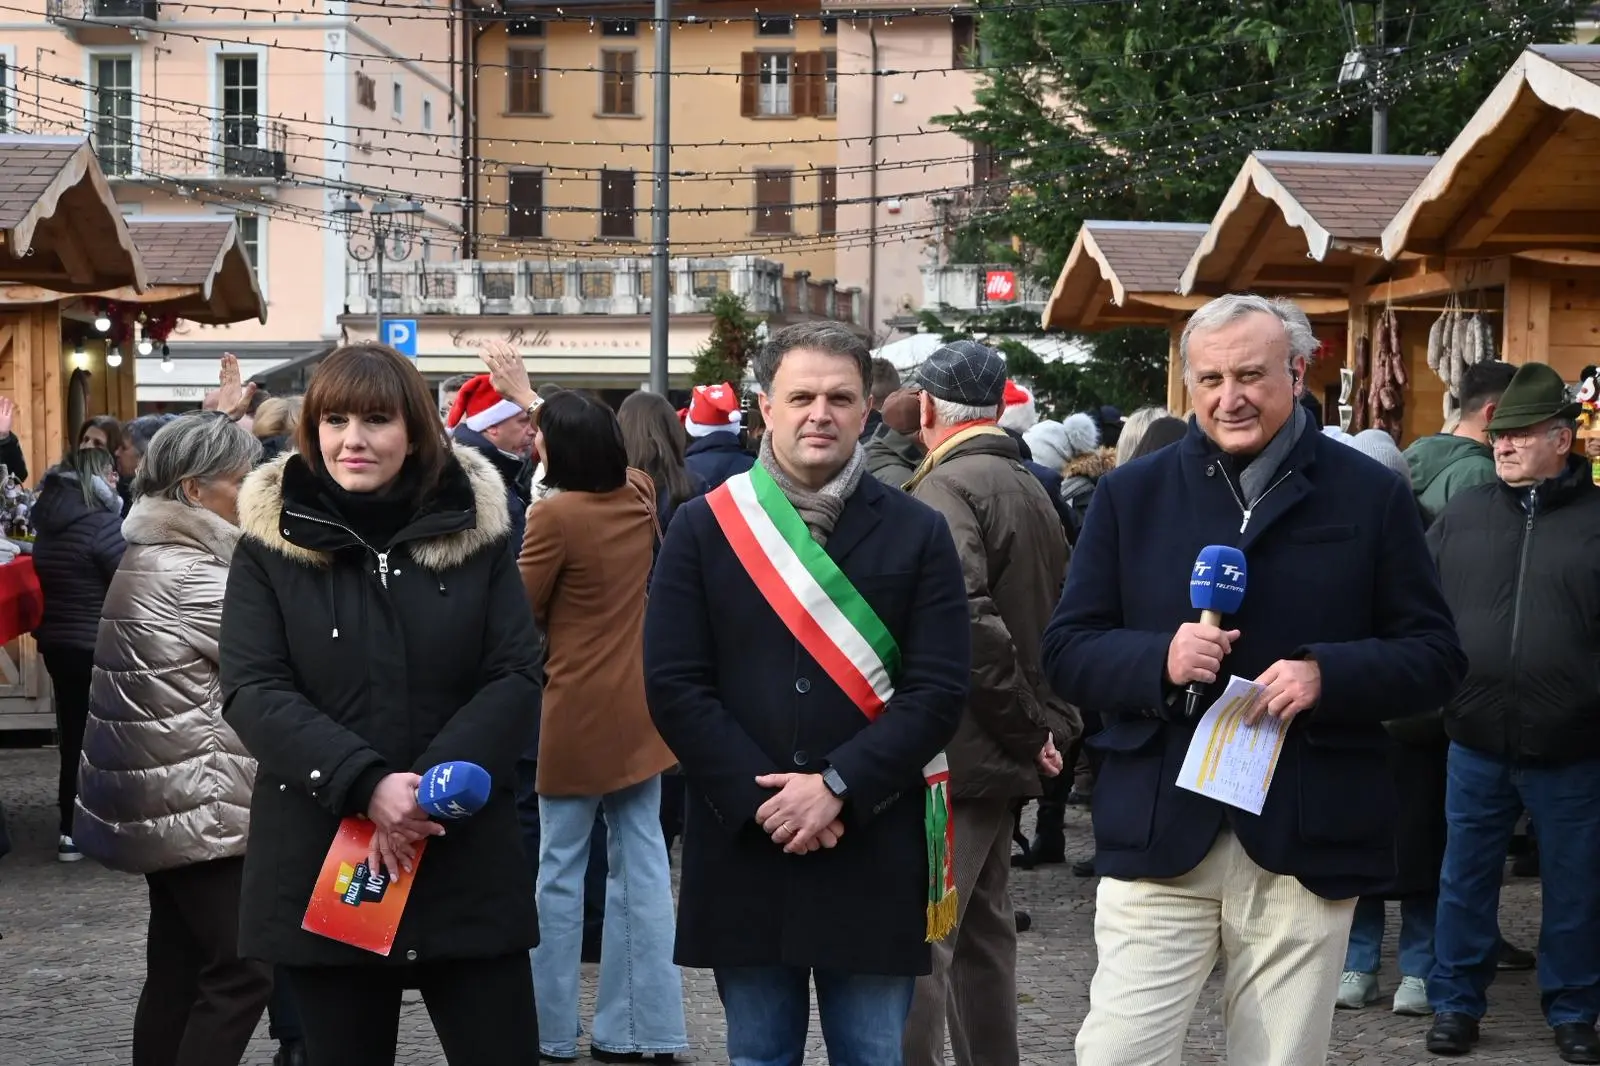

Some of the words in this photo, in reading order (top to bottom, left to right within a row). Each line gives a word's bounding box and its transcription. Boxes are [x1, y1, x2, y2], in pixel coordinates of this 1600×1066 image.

[987, 275, 1012, 298] illy
[388, 323, 410, 350] P
[344, 881, 361, 905] PIAZZA
